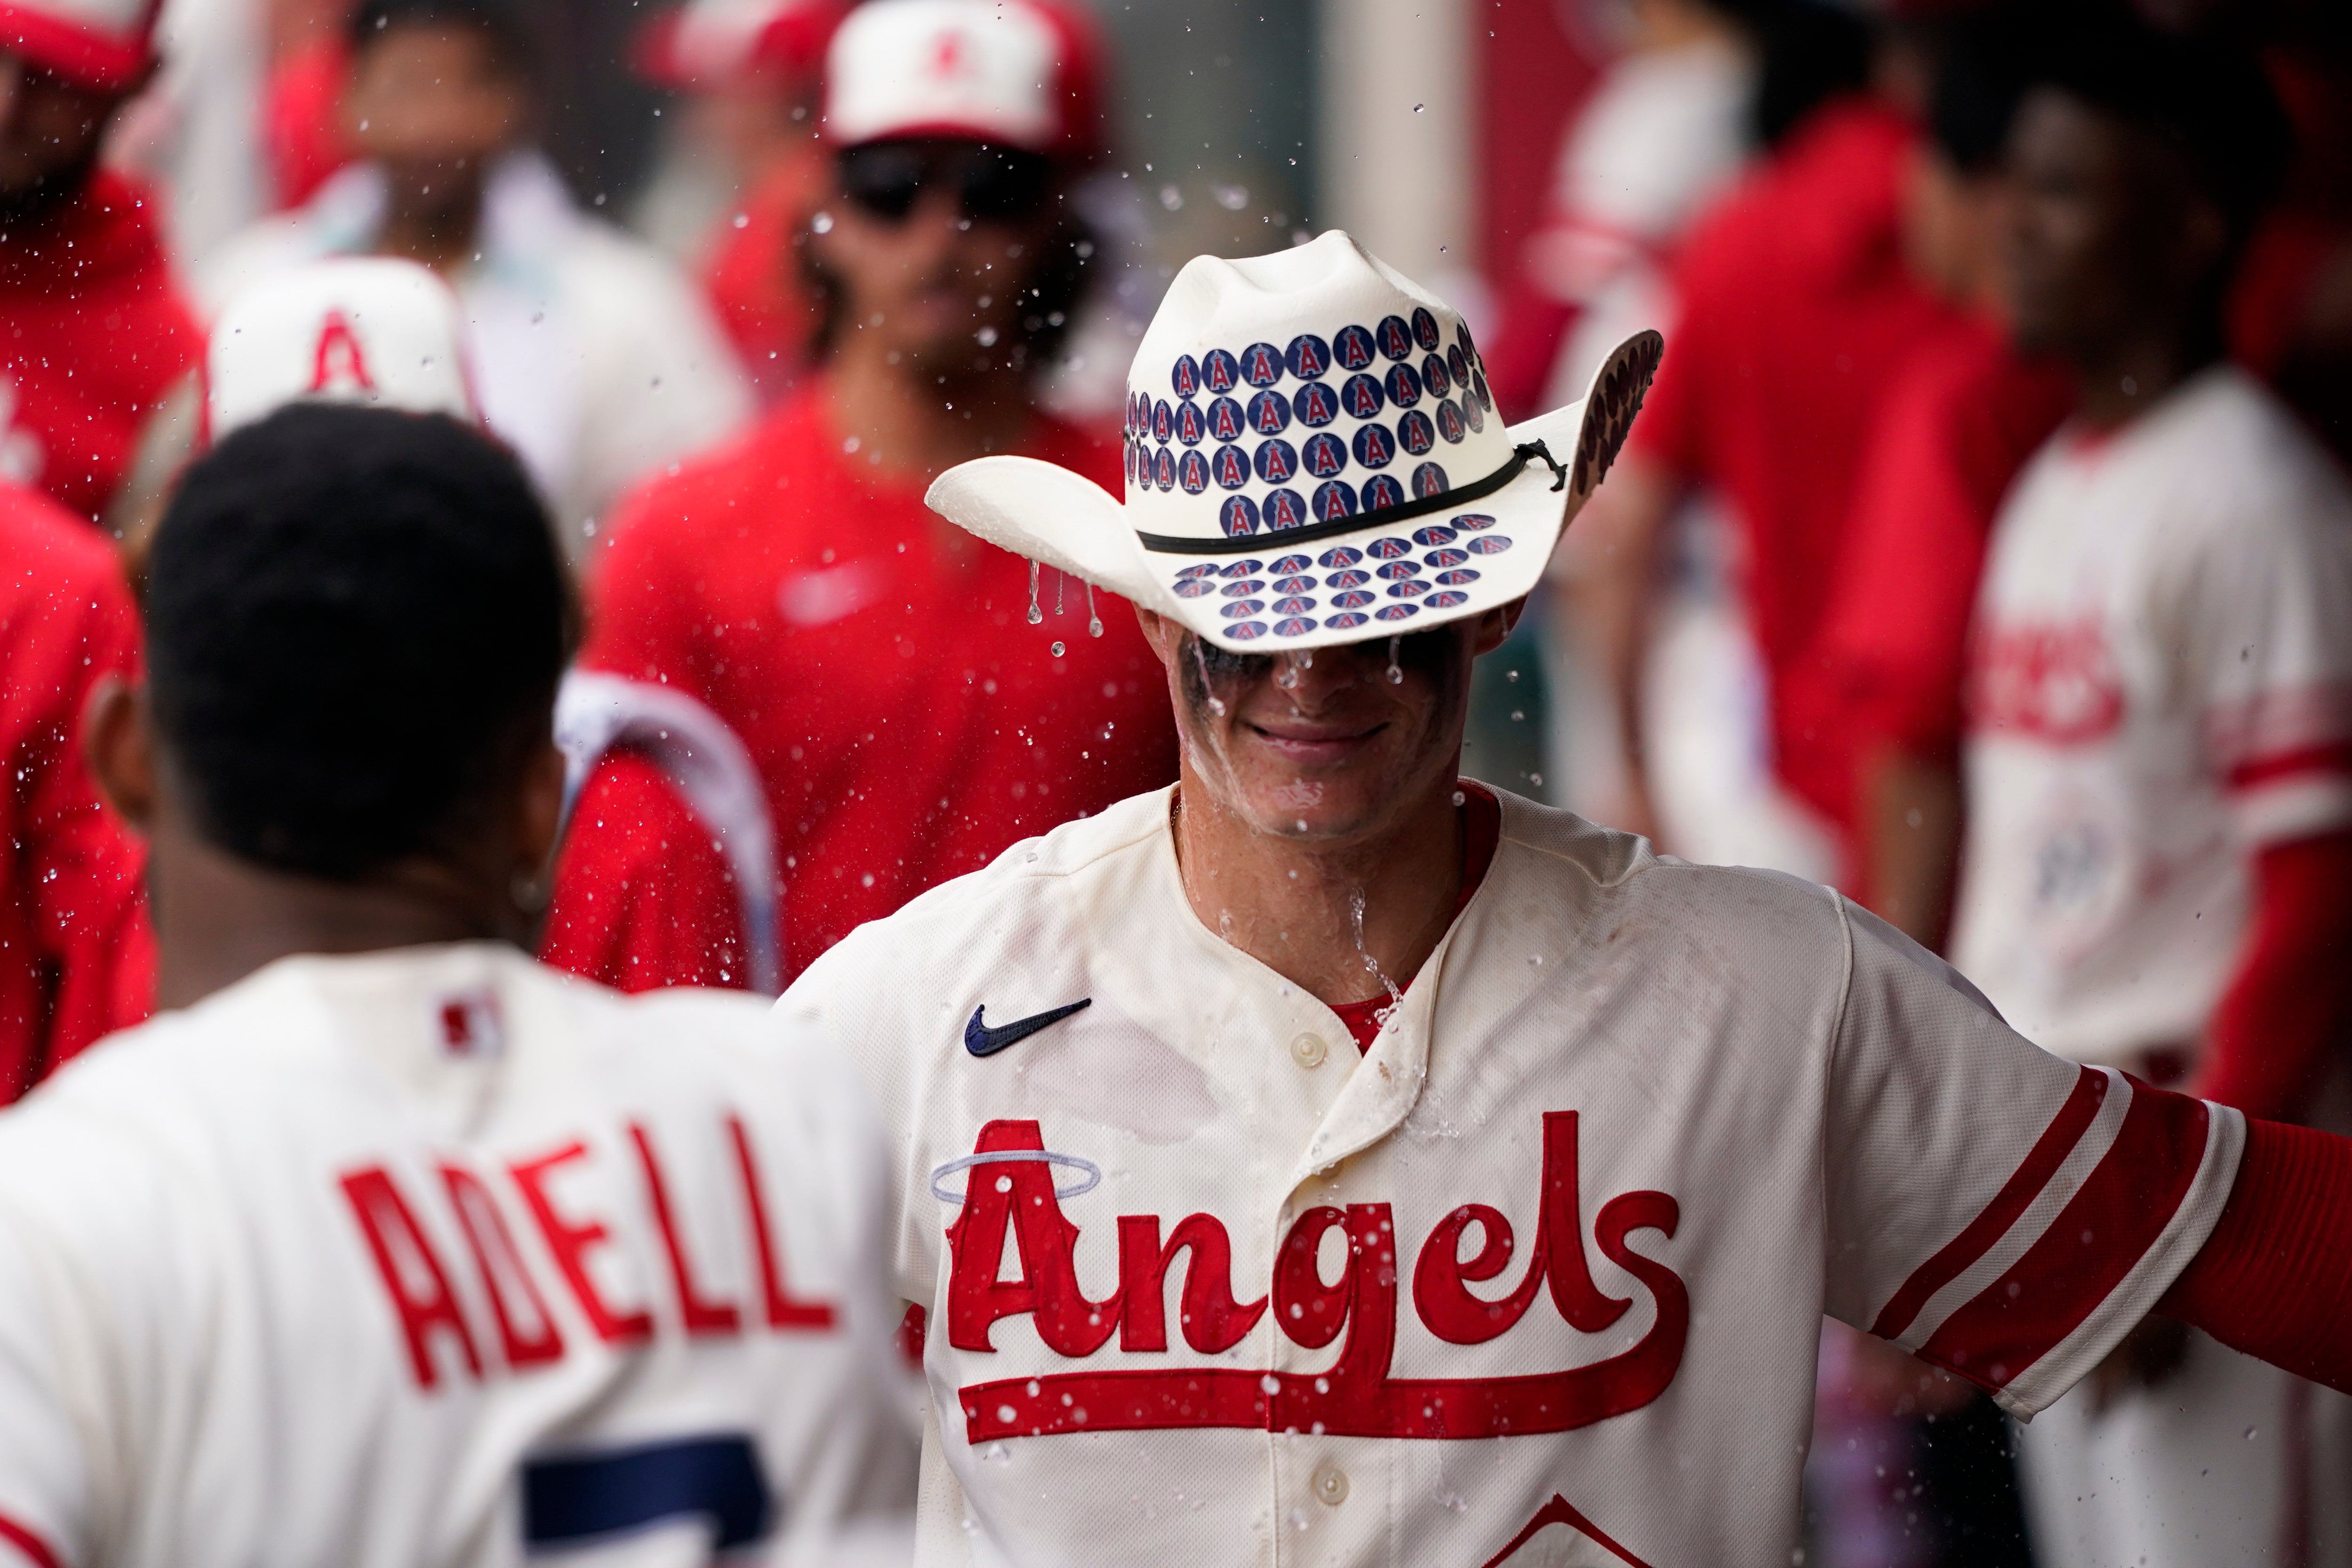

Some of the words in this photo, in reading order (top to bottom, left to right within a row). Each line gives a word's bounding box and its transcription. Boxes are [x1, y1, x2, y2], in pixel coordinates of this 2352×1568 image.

[1388, 319, 1410, 359] A
[1418, 312, 1438, 348] A
[307, 308, 377, 394] A
[1251, 347, 1276, 384] A
[1297, 339, 1324, 377] A
[1345, 330, 1371, 369] A
[1178, 360, 1196, 396] A
[1210, 352, 1232, 390] A
[1398, 366, 1419, 406] A
[1428, 358, 1448, 396] A
[1257, 395, 1284, 432] A
[1306, 386, 1332, 425] A
[1354, 378, 1379, 417] A
[1156, 403, 1169, 440] A
[1181, 404, 1200, 442] A
[1215, 400, 1238, 438] A
[1408, 414, 1430, 452] A
[1447, 404, 1464, 442] A
[1264, 443, 1291, 482] A
[1314, 437, 1341, 476] A
[1365, 428, 1390, 466] A
[1158, 452, 1172, 487] A
[1184, 454, 1204, 491] A
[1220, 449, 1244, 486] A
[1422, 467, 1441, 499] A
[1273, 492, 1300, 531] A
[1323, 485, 1349, 521] A
[1373, 479, 1394, 511] A
[1229, 499, 1254, 537] A
[1462, 517, 1495, 531] A
[1380, 539, 1406, 558] A
[1427, 528, 1454, 546] A
[1481, 538, 1506, 554] A
[1227, 561, 1251, 578] A
[1277, 556, 1302, 574] A
[1330, 549, 1355, 568] A
[1390, 562, 1413, 579] A
[1438, 550, 1463, 567] A
[1229, 581, 1254, 596] A
[1282, 577, 1307, 594] A
[1338, 571, 1363, 588] A
[1400, 582, 1425, 597] A
[1450, 571, 1475, 585] A
[1232, 601, 1255, 618] A
[1280, 598, 1304, 614] A
[1343, 592, 1366, 608] A
[1384, 606, 1410, 620] A
[1435, 592, 1461, 607] A
[1232, 623, 1259, 640] A
[1282, 618, 1309, 635] A
[1334, 614, 1360, 629] A
[337, 1108, 840, 1394] ADELL
[945, 1110, 1689, 1444] Angels
